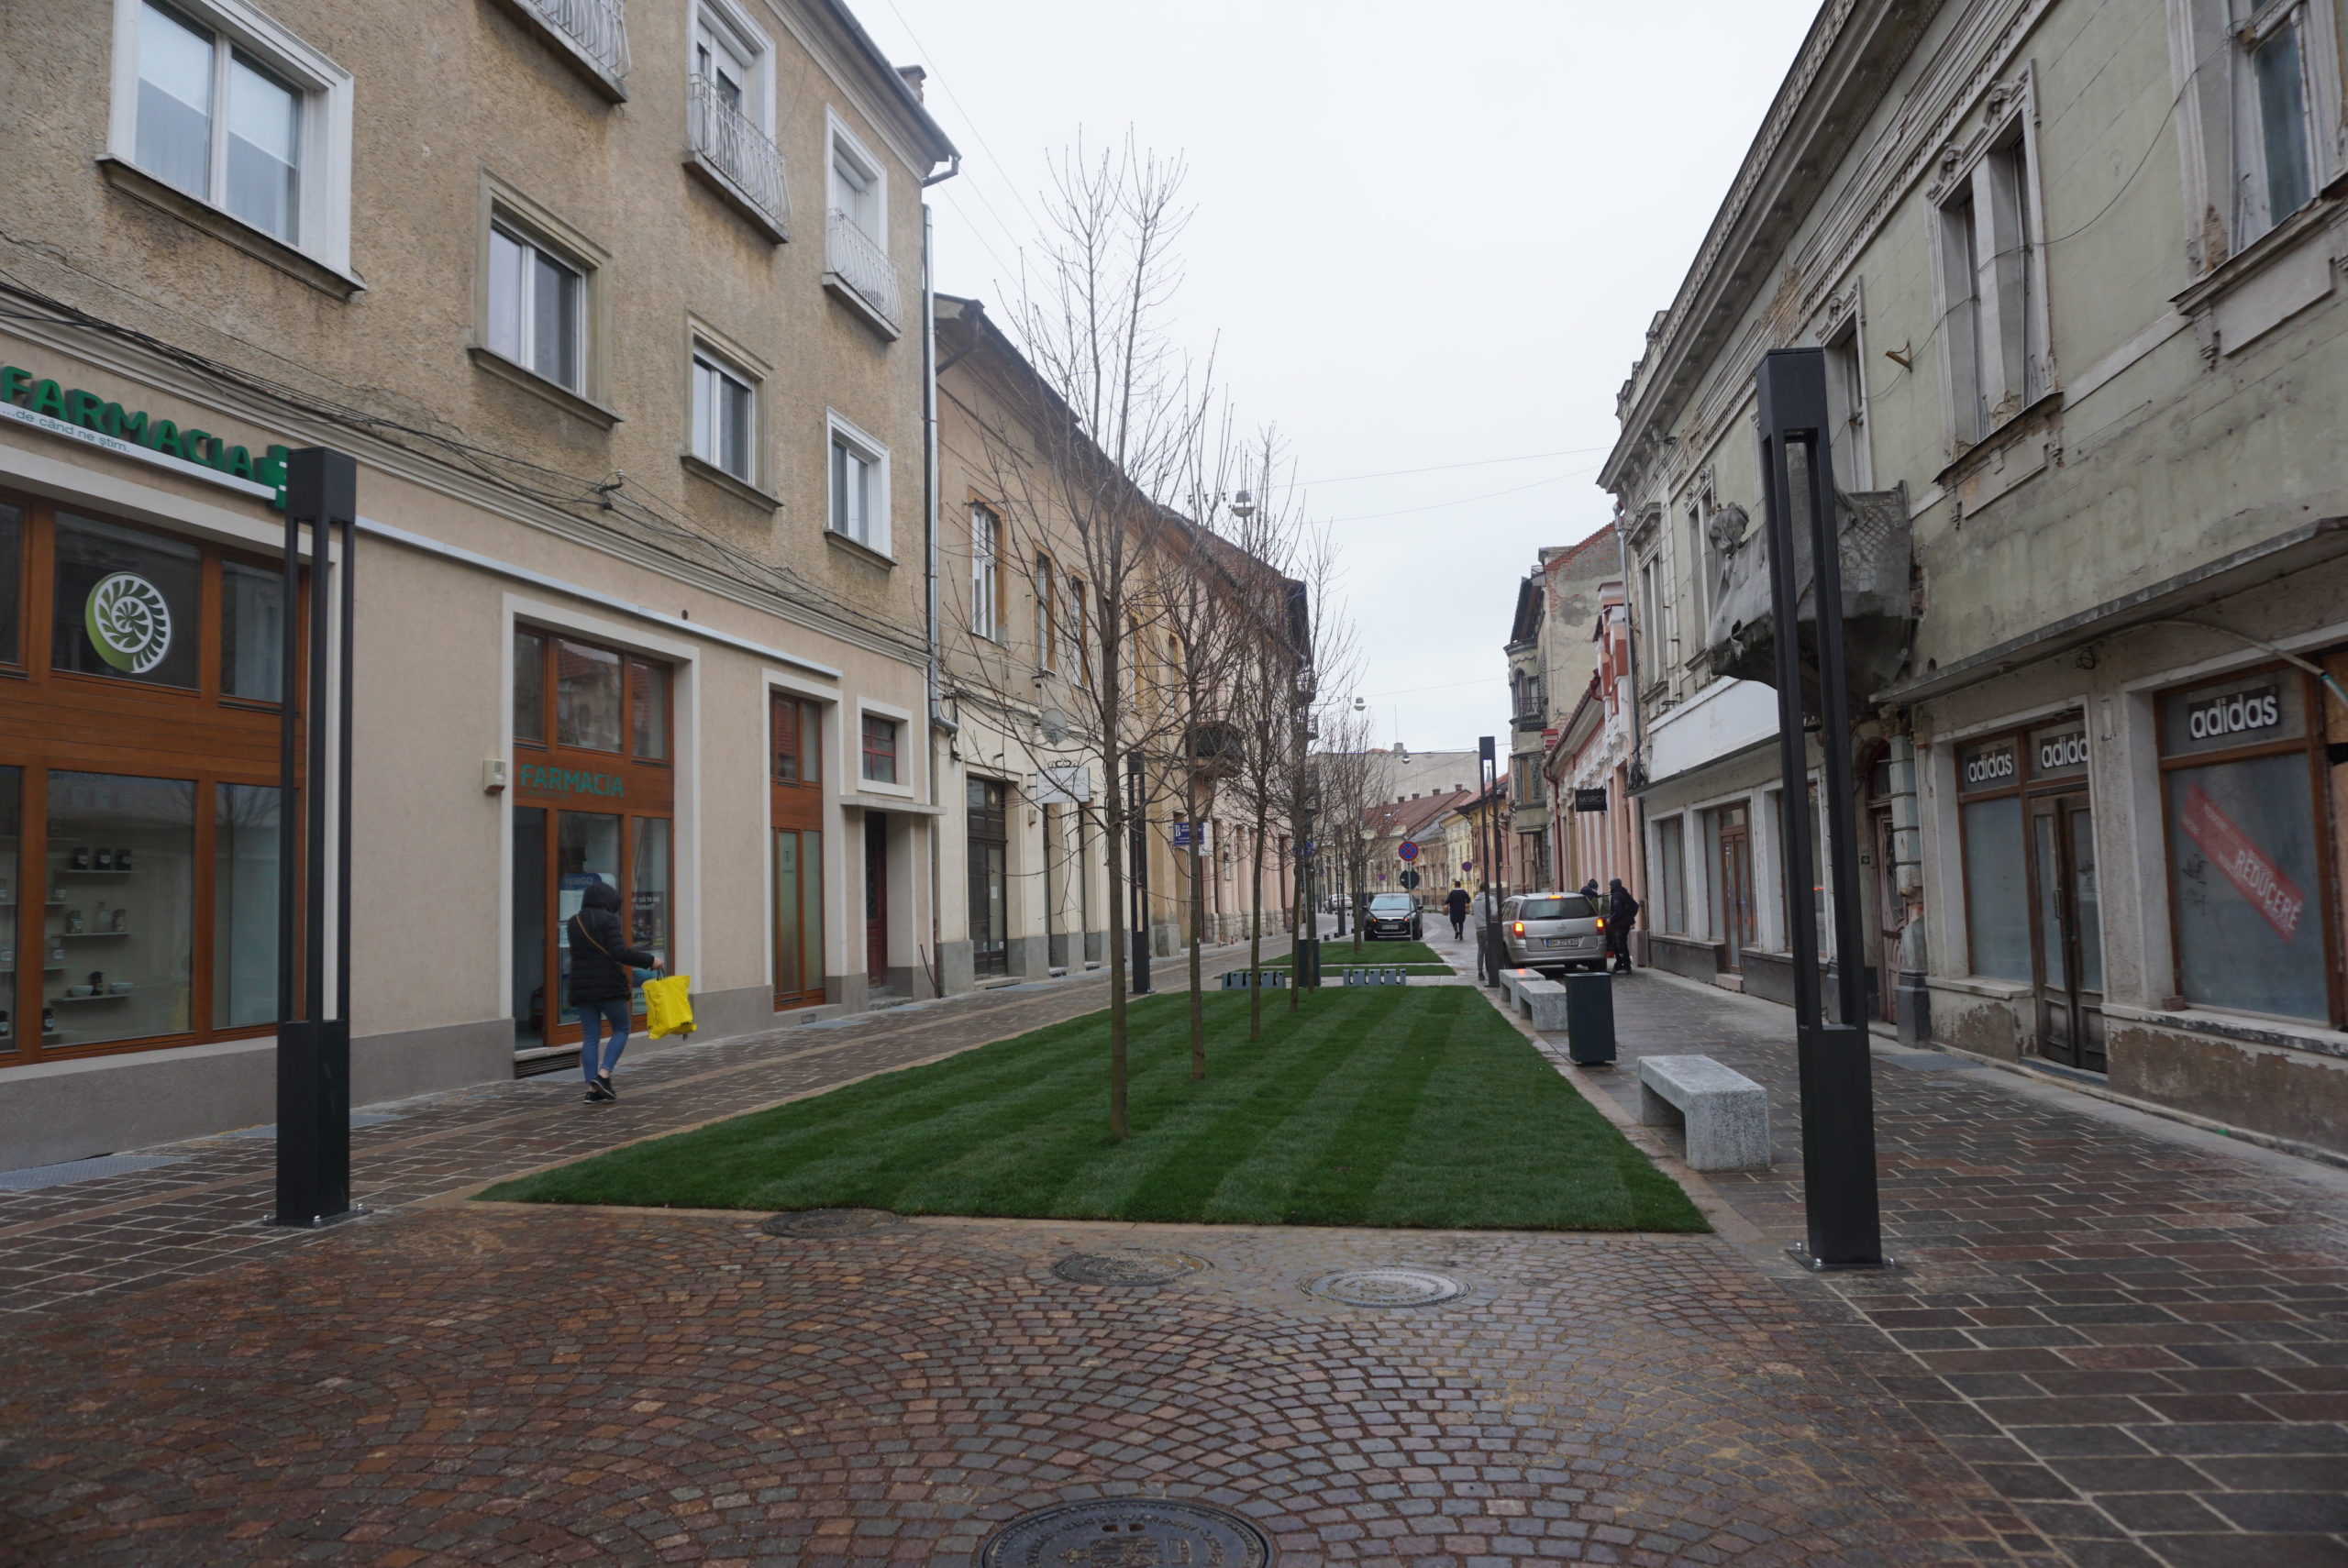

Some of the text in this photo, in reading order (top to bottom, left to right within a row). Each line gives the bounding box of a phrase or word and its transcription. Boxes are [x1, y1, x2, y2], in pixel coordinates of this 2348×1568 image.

[1, 366, 258, 482] FARMACIA
[39, 417, 74, 436] când
[78, 429, 95, 441] ne
[2190, 693, 2278, 739] adidas
[1968, 751, 2013, 783] adidas
[2042, 734, 2089, 768] adida
[520, 764, 625, 797] FARMACIA
[2234, 849, 2299, 929] REDUCERE
